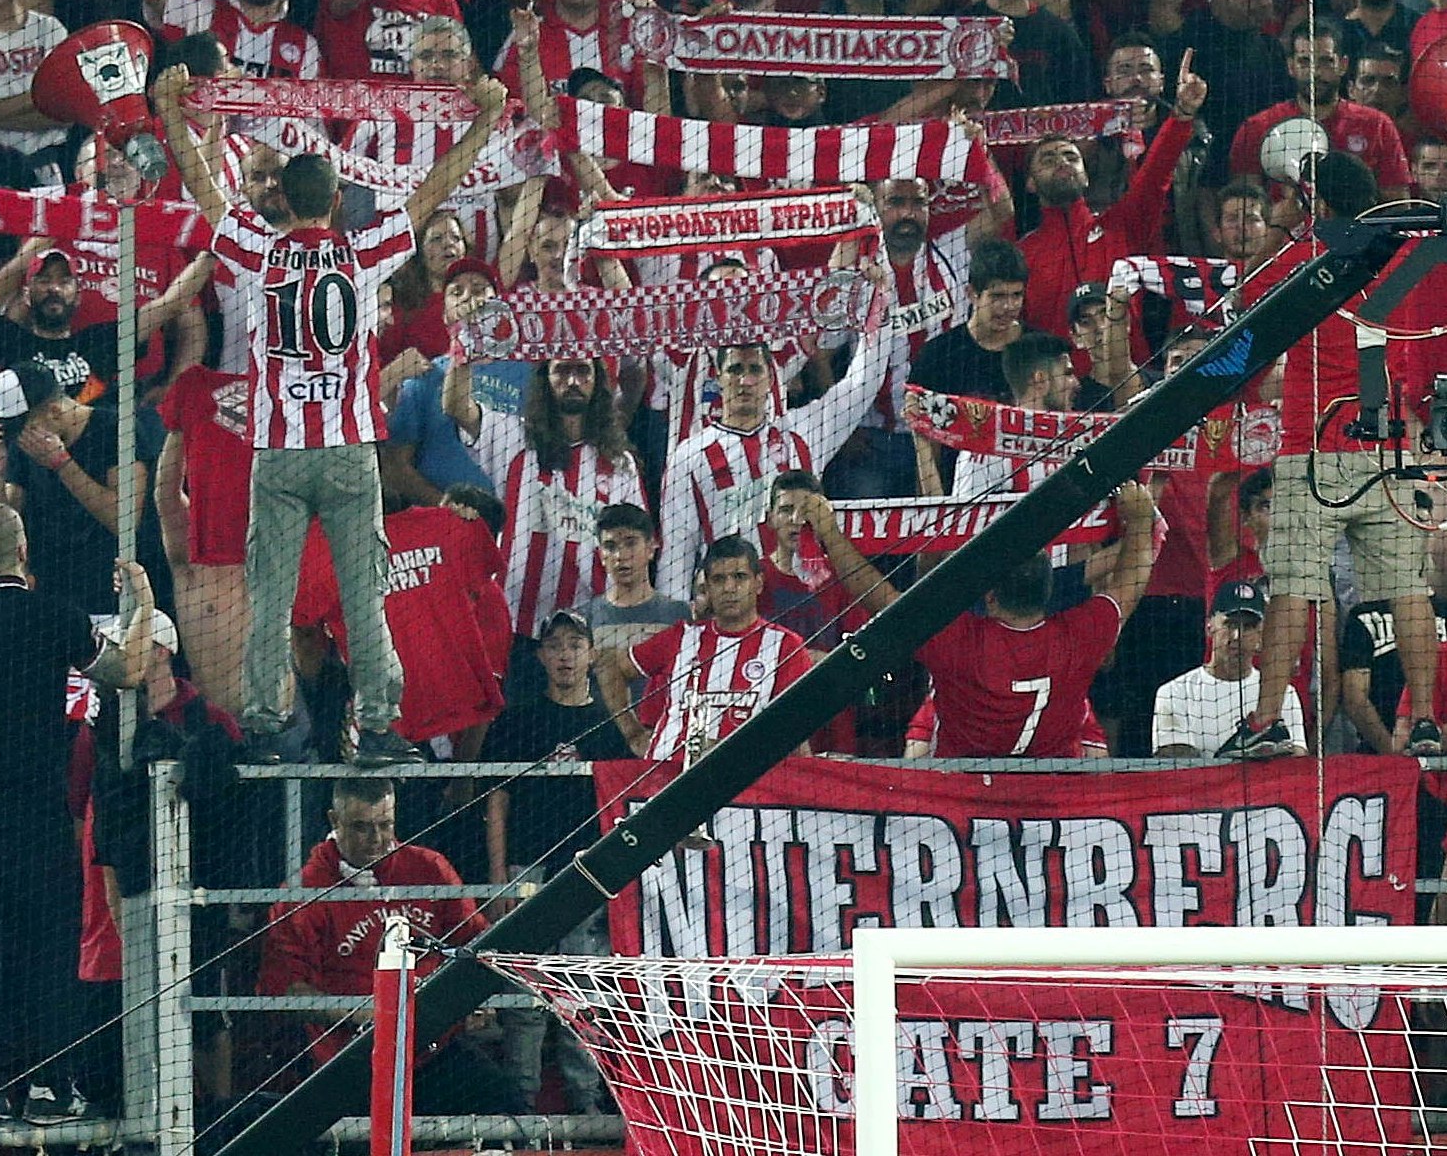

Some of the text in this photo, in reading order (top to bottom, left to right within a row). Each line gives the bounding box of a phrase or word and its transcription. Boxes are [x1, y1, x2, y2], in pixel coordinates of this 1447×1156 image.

[716, 25, 944, 62] ΟΛΥΜΠΙΑΚΟΣ
[263, 273, 356, 359] 10
[524, 290, 809, 344] ΟΛΥΜΠΙΑΚΟΣ
[889, 293, 953, 333] EMENS
[287, 371, 342, 402] citi
[1010, 676, 1051, 756] 7
[1165, 1016, 1227, 1120] 7
